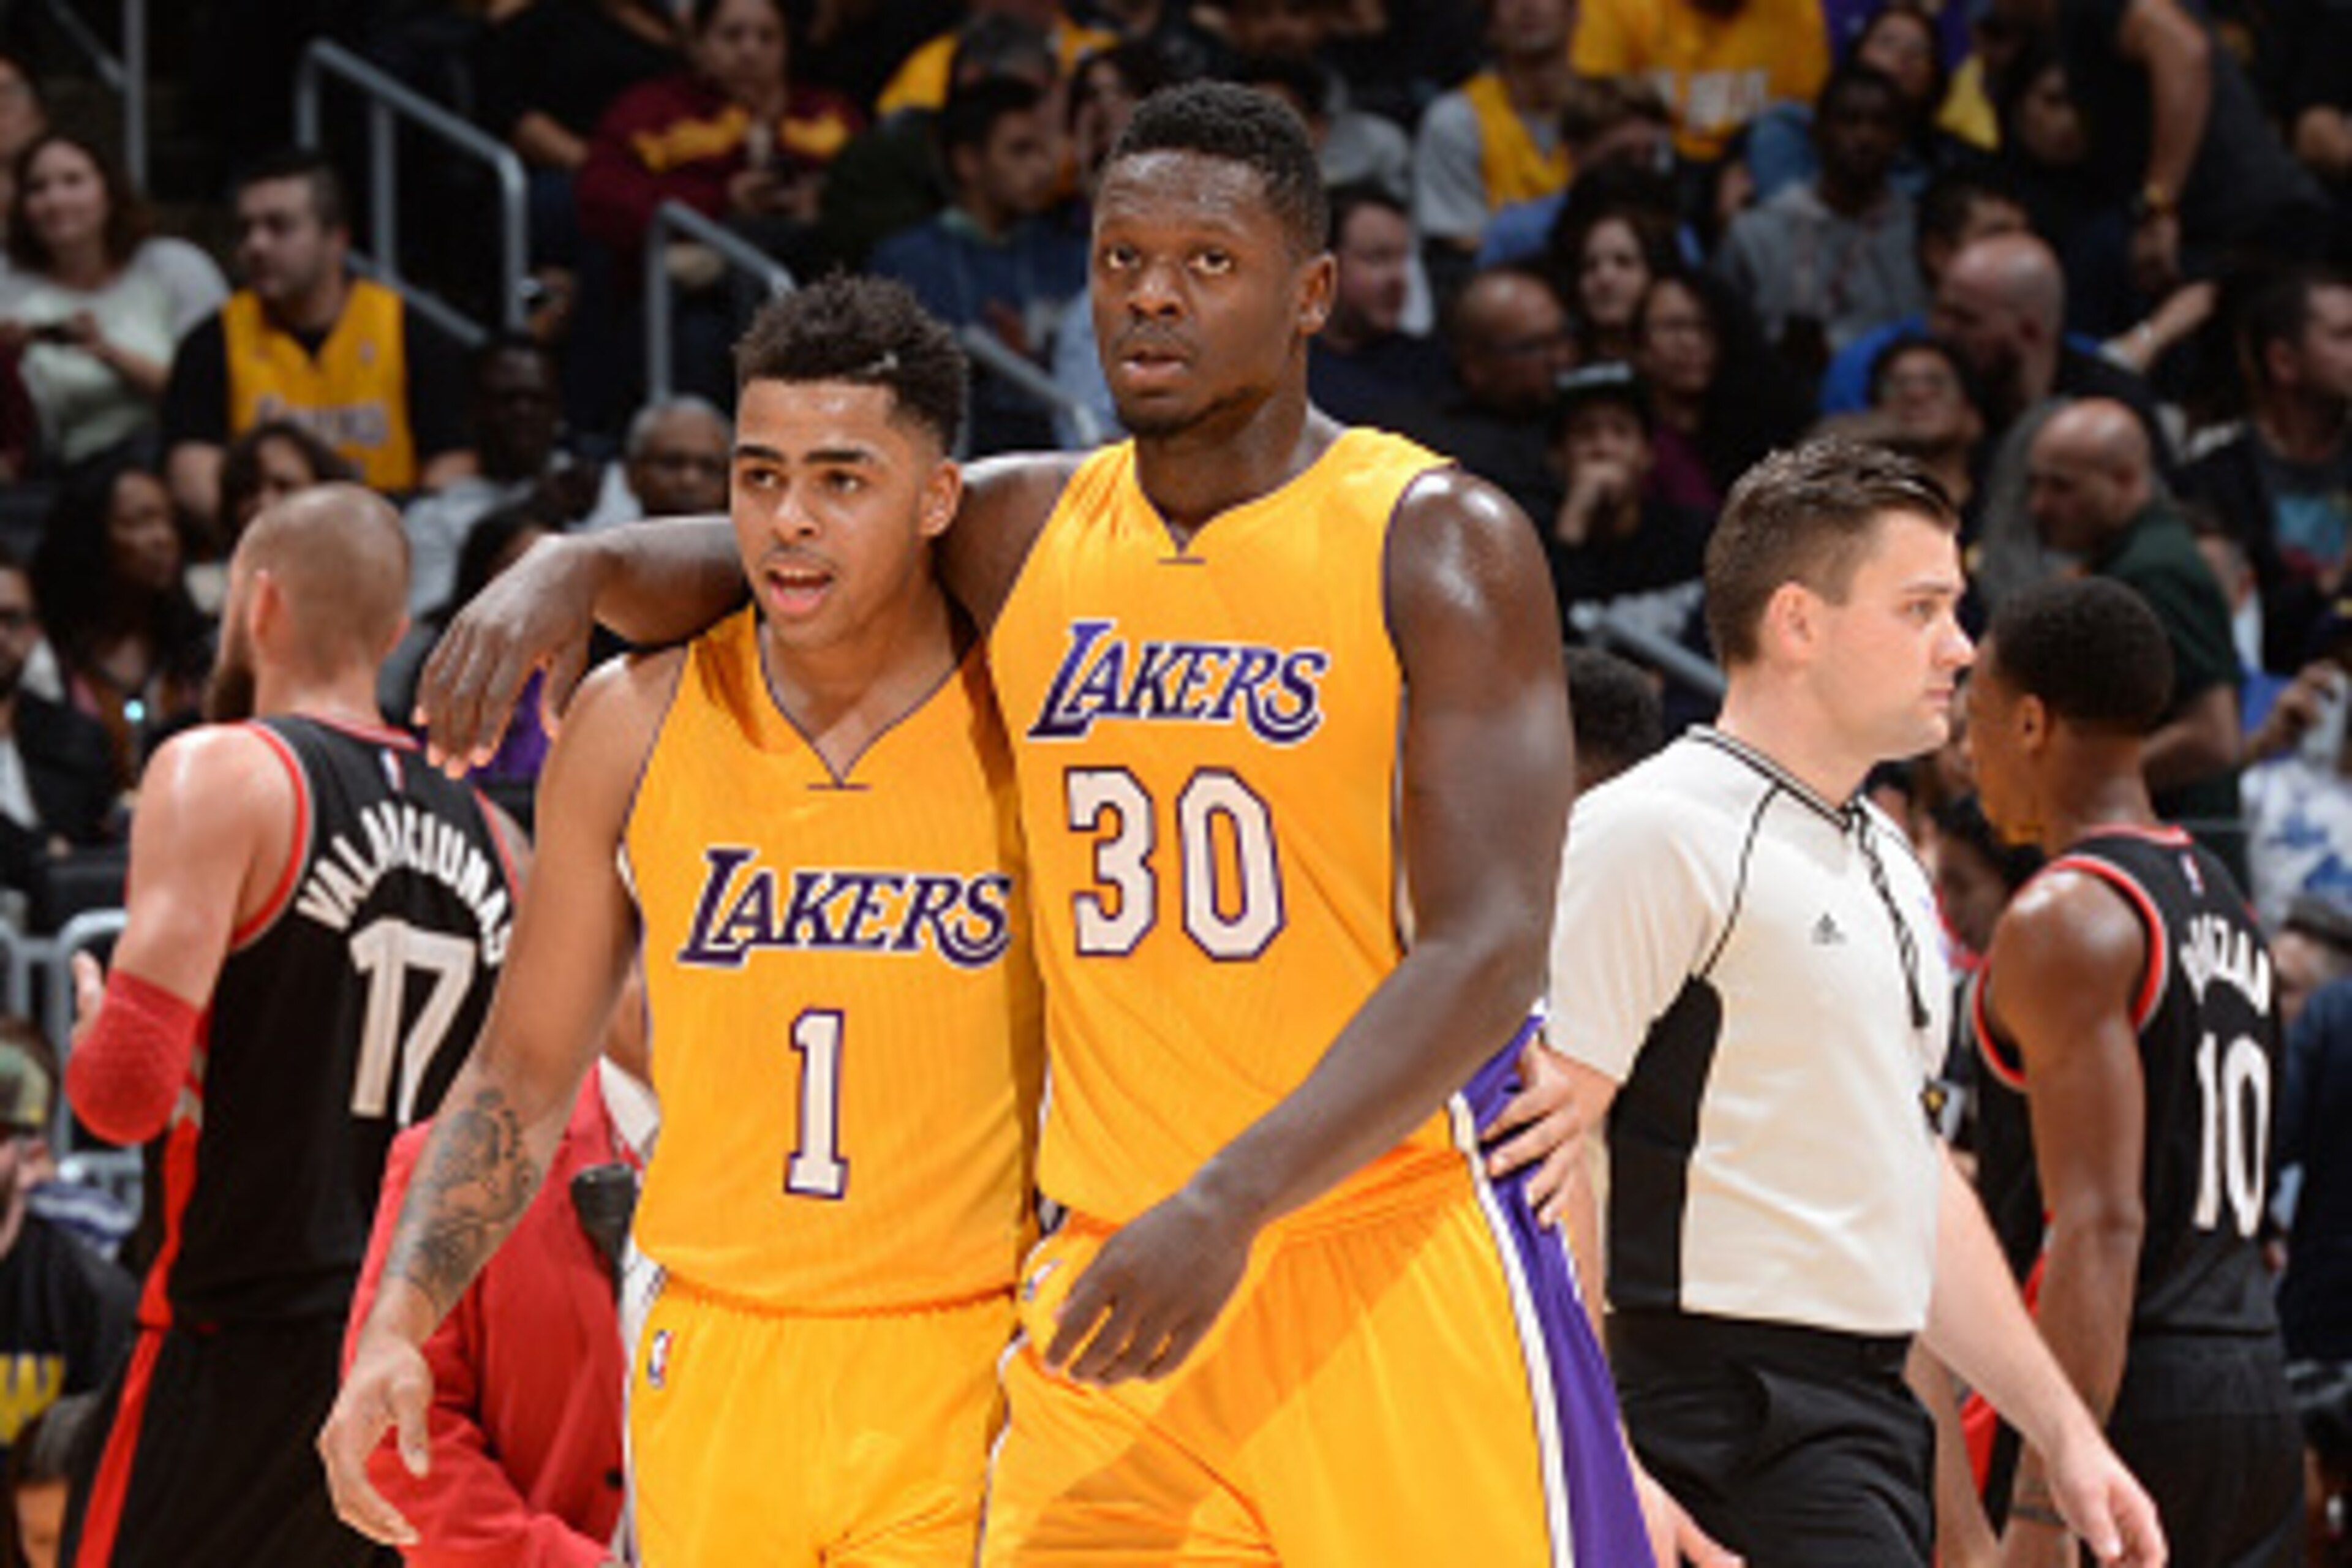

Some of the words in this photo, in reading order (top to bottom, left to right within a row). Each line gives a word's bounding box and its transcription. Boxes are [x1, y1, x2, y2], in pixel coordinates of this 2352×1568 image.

[1026, 620, 1330, 745] LAKERS
[675, 846, 1014, 968] LAKERS
[1064, 765, 1288, 963] 30
[349, 915, 477, 1127] 17
[783, 1006, 850, 1200] 1
[2193, 1031, 2270, 1238] 10
